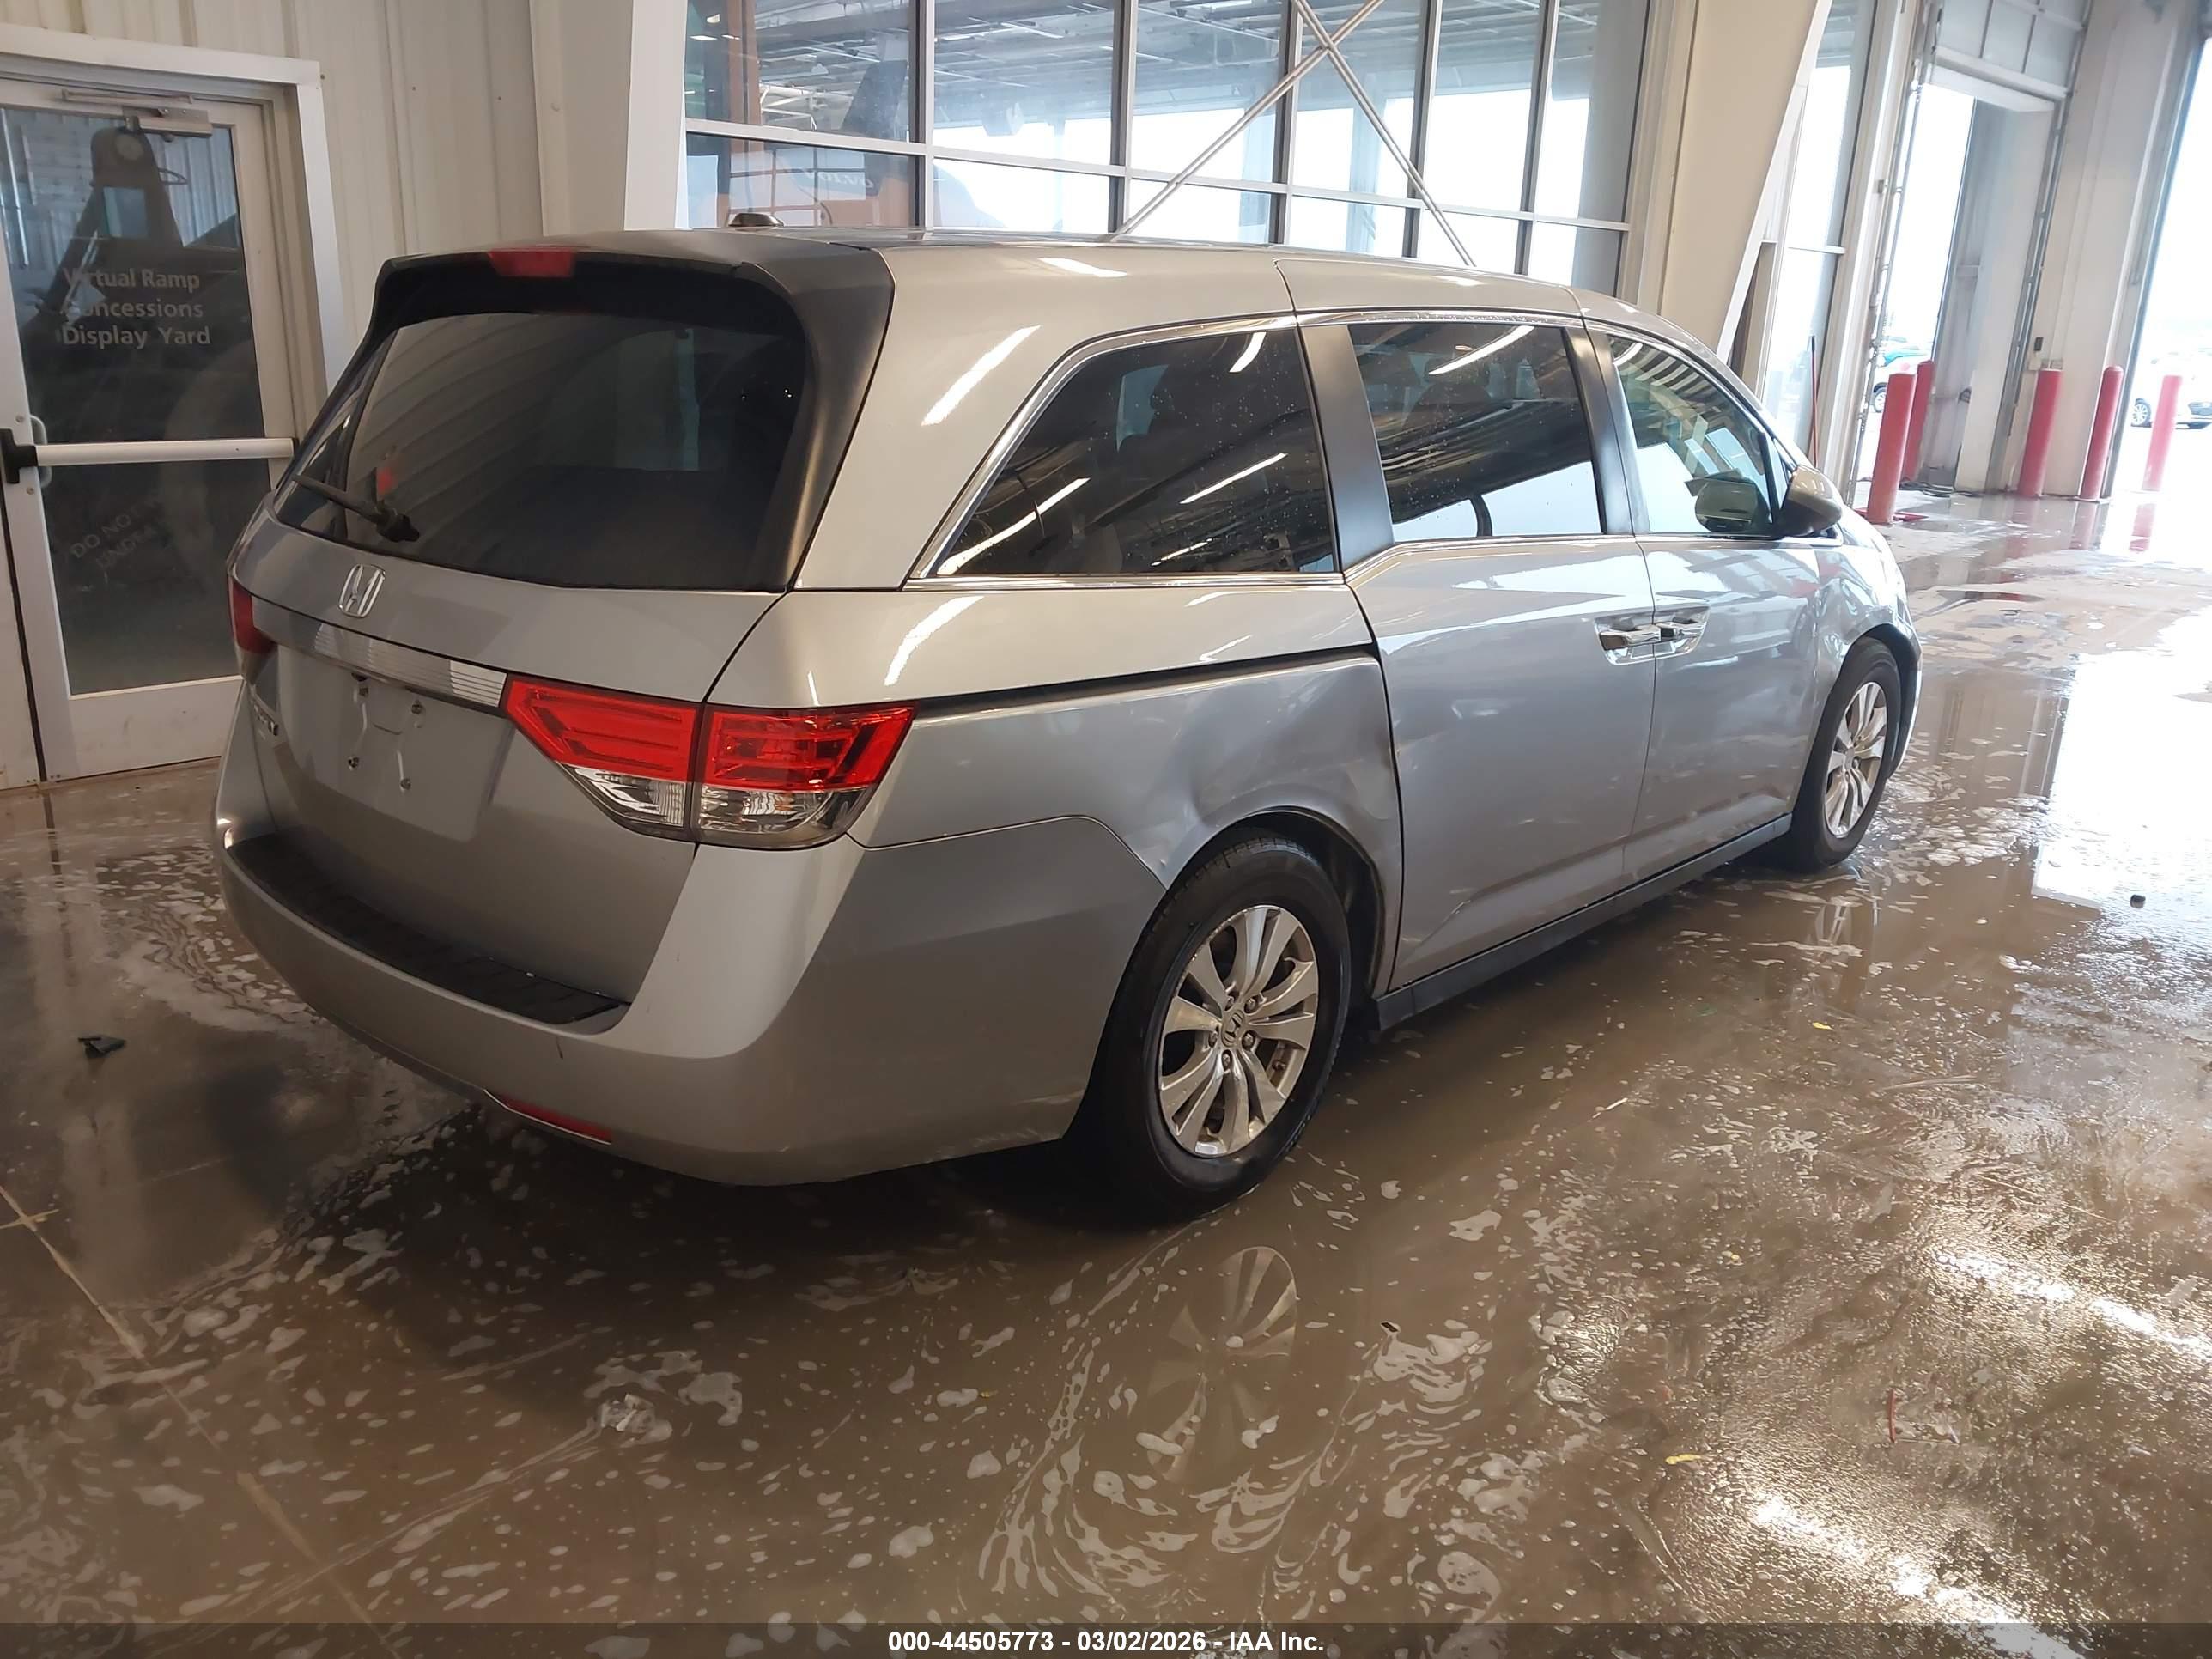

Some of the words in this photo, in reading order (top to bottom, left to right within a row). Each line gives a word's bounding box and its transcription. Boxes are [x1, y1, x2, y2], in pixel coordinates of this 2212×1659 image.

[142, 269, 200, 293] Ramp
[62, 298, 203, 318] oncessions
[62, 325, 147, 349] Display
[158, 326, 210, 344] Yard
